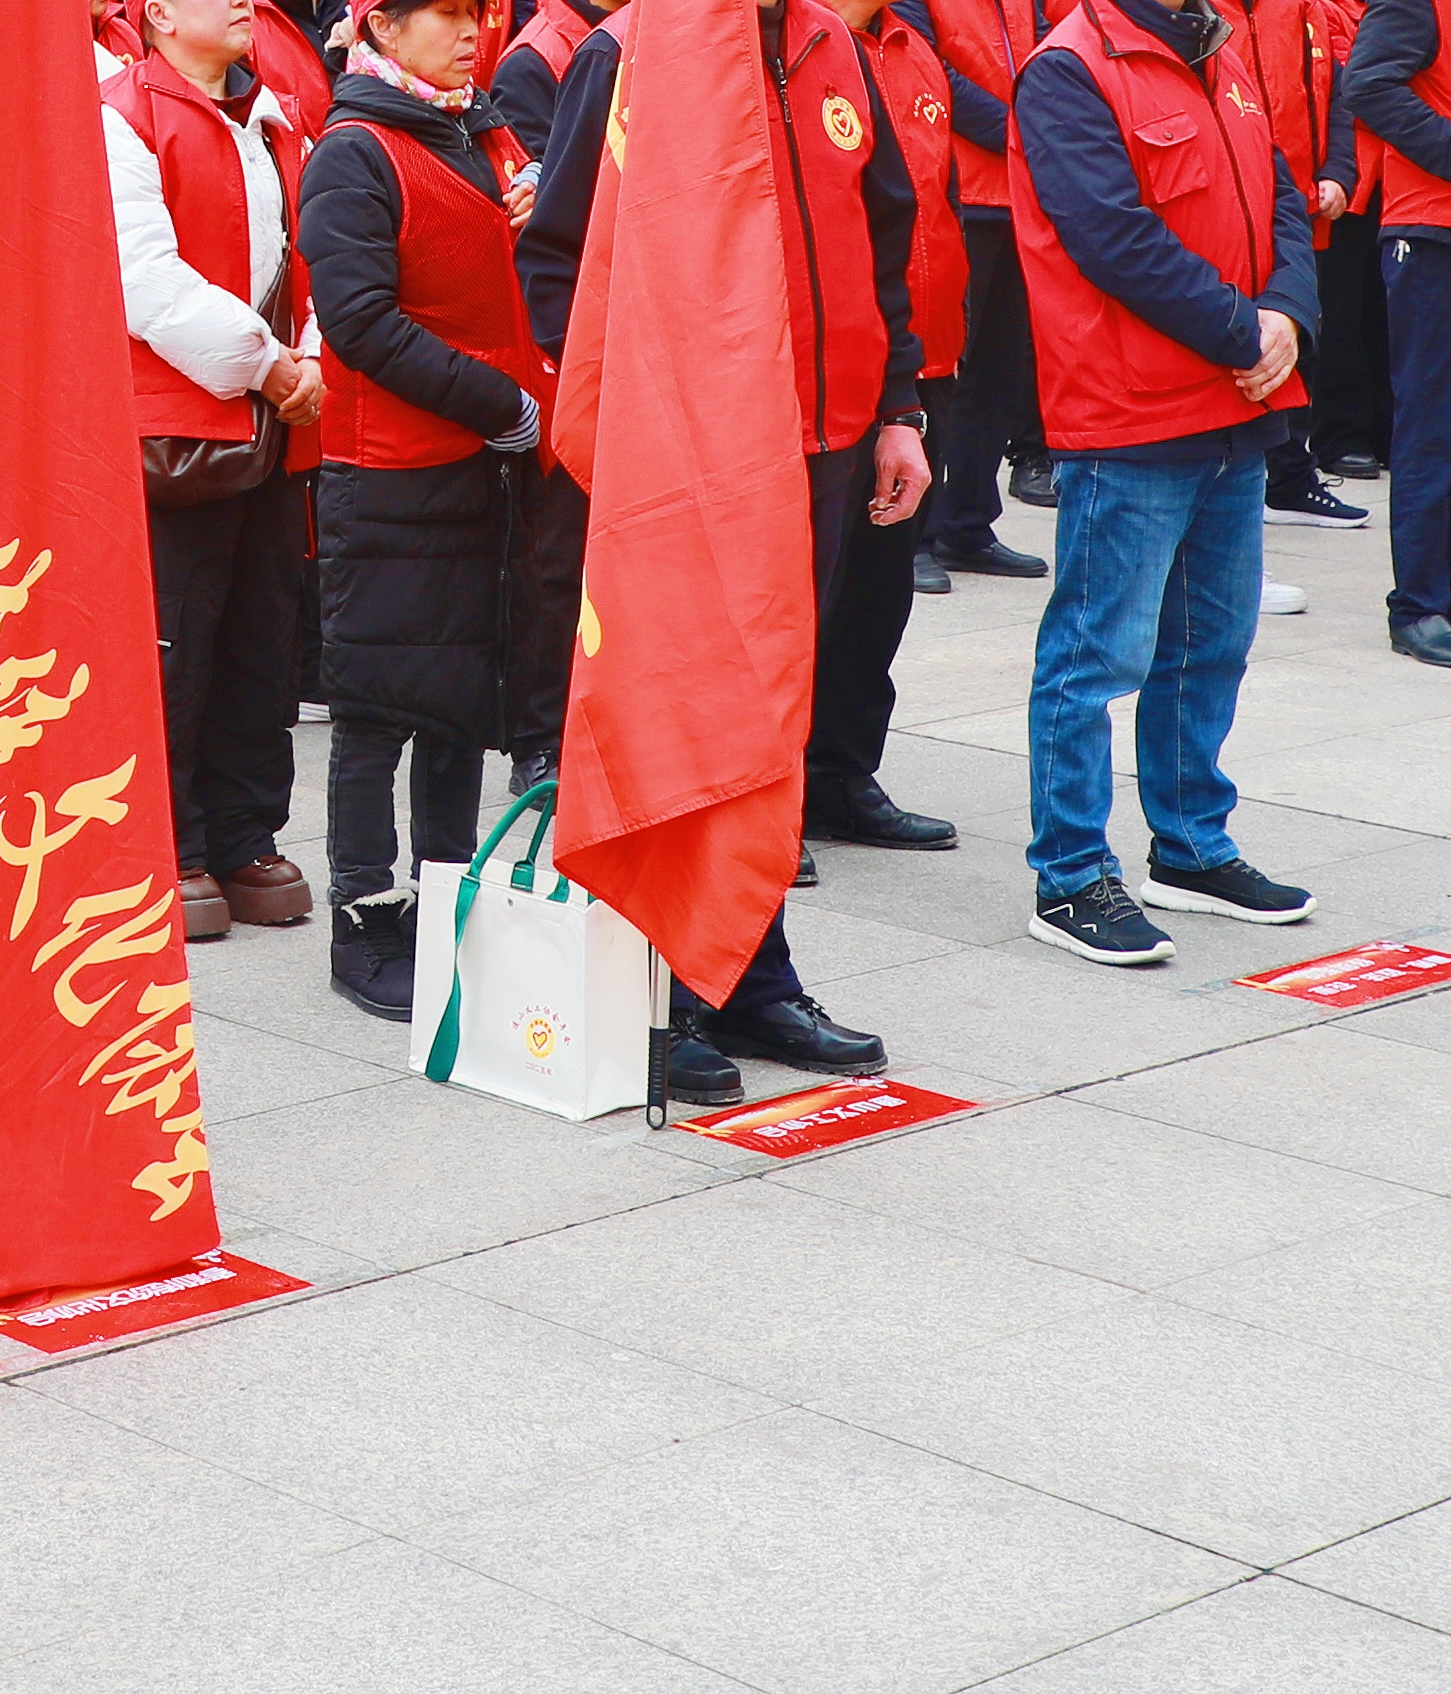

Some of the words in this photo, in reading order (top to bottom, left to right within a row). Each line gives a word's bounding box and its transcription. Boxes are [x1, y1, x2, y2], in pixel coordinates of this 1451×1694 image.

[752, 1094, 907, 1138] 通山义工协会
